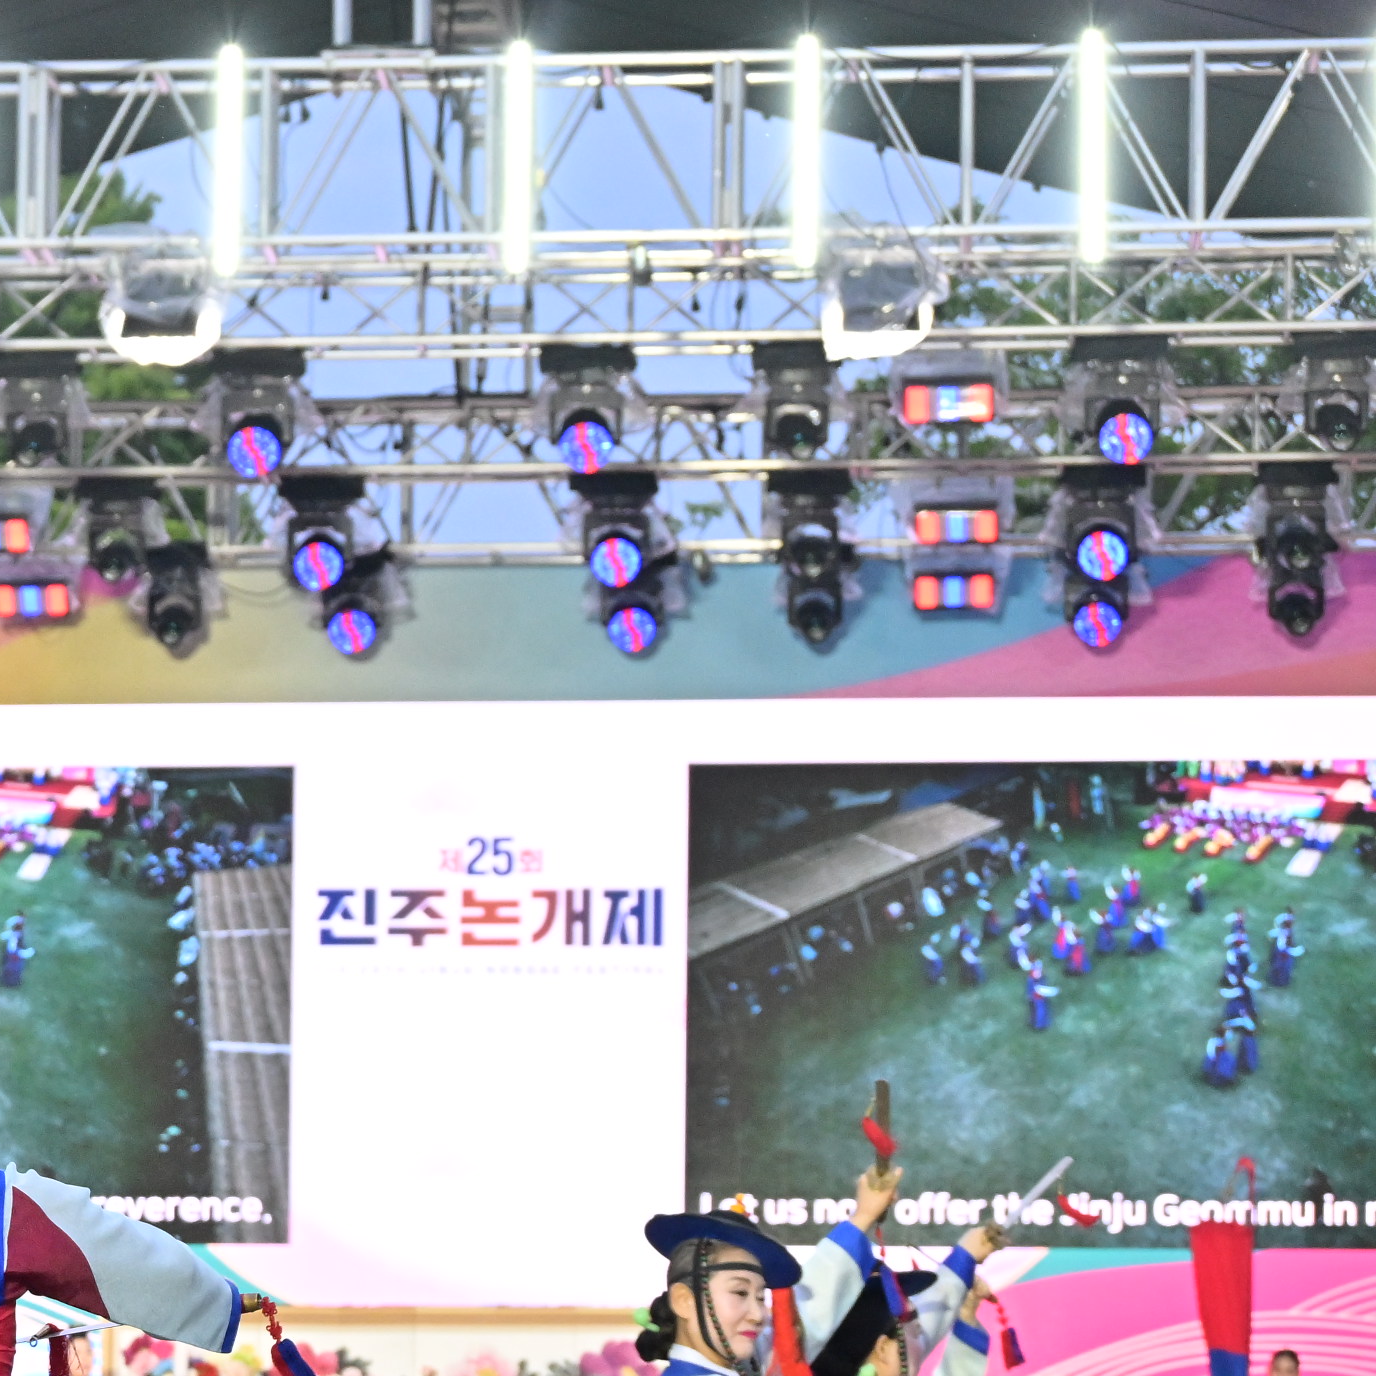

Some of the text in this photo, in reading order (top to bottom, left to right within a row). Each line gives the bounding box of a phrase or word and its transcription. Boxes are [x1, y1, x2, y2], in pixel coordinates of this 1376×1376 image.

[317, 888, 663, 946] 진주논개제
[763, 1198, 808, 1225] us
[813, 1198, 858, 1225] no
[894, 1191, 987, 1226] offer
[992, 1191, 1055, 1226] the
[1059, 1192, 1147, 1234] Jinju
[1323, 1192, 1358, 1227] in
